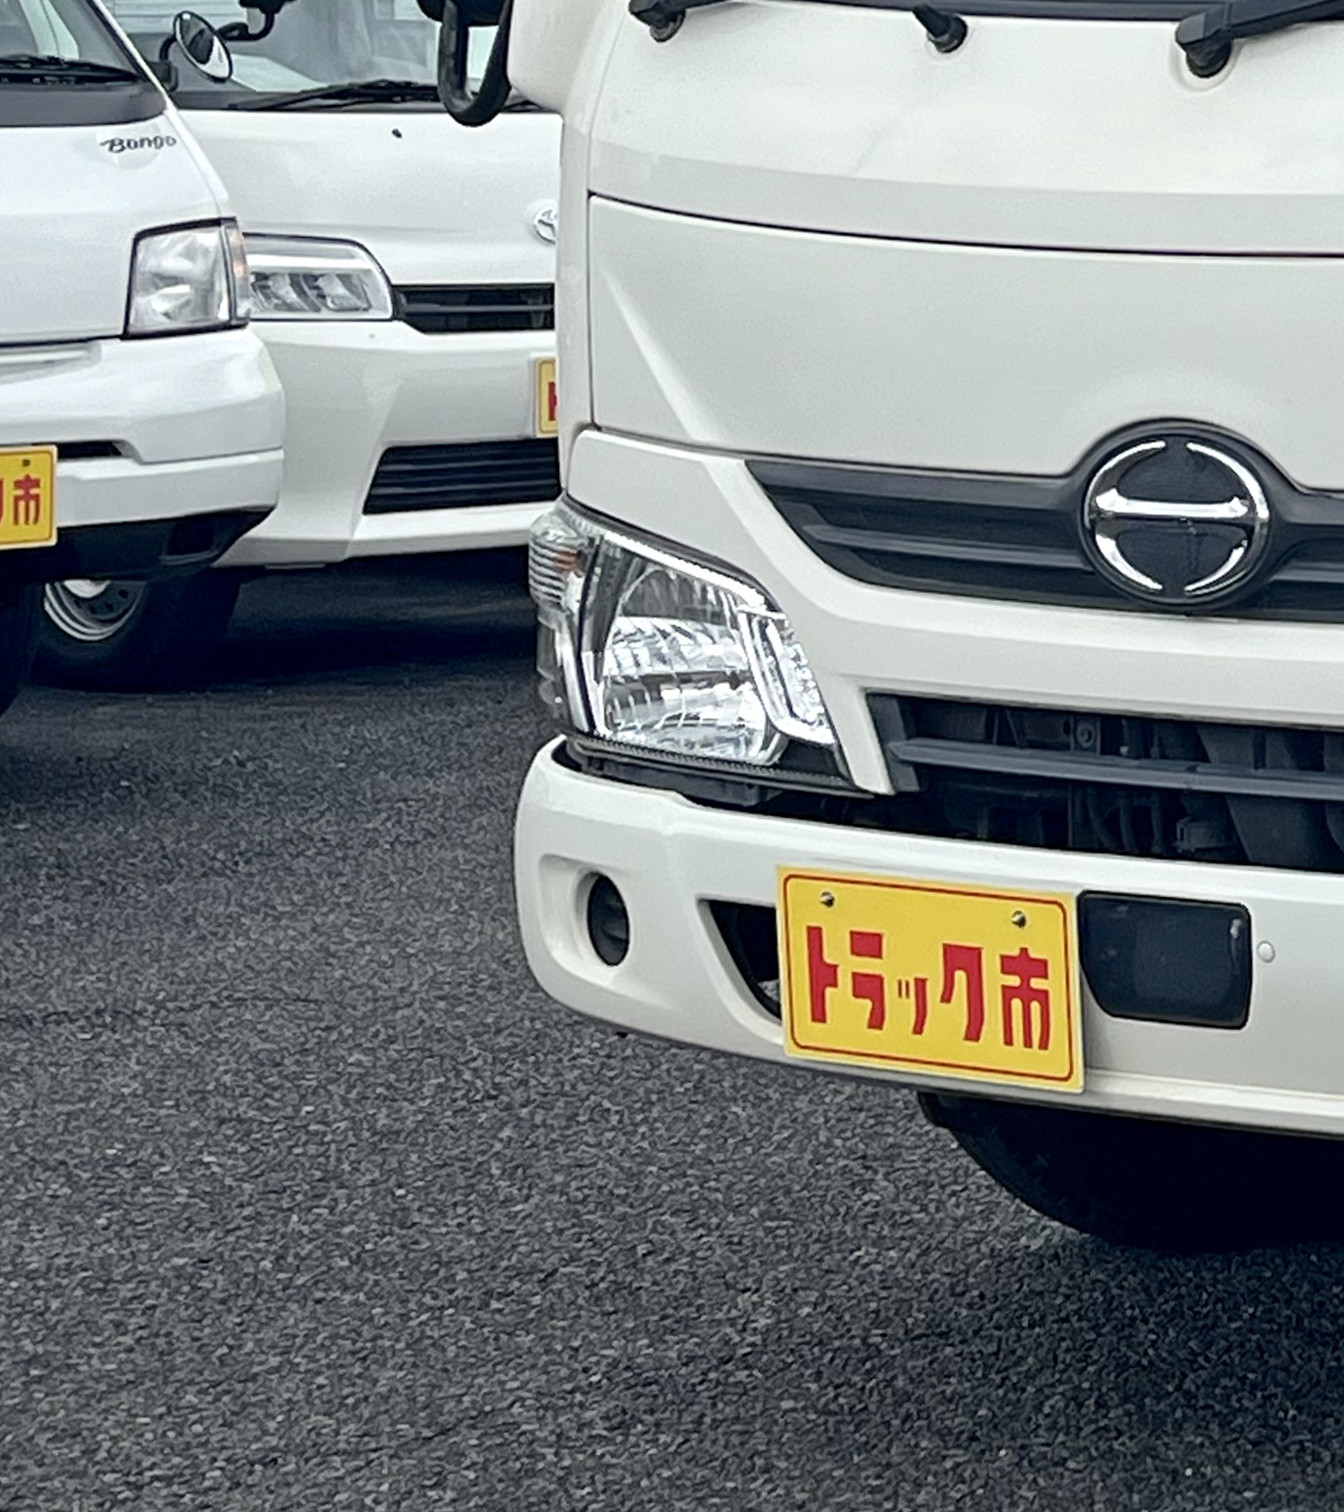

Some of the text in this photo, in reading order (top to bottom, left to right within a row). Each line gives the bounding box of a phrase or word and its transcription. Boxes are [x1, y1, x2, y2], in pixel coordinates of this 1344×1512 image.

[99, 135, 177, 154] Bongo
[806, 925, 1050, 1050] トラック市
